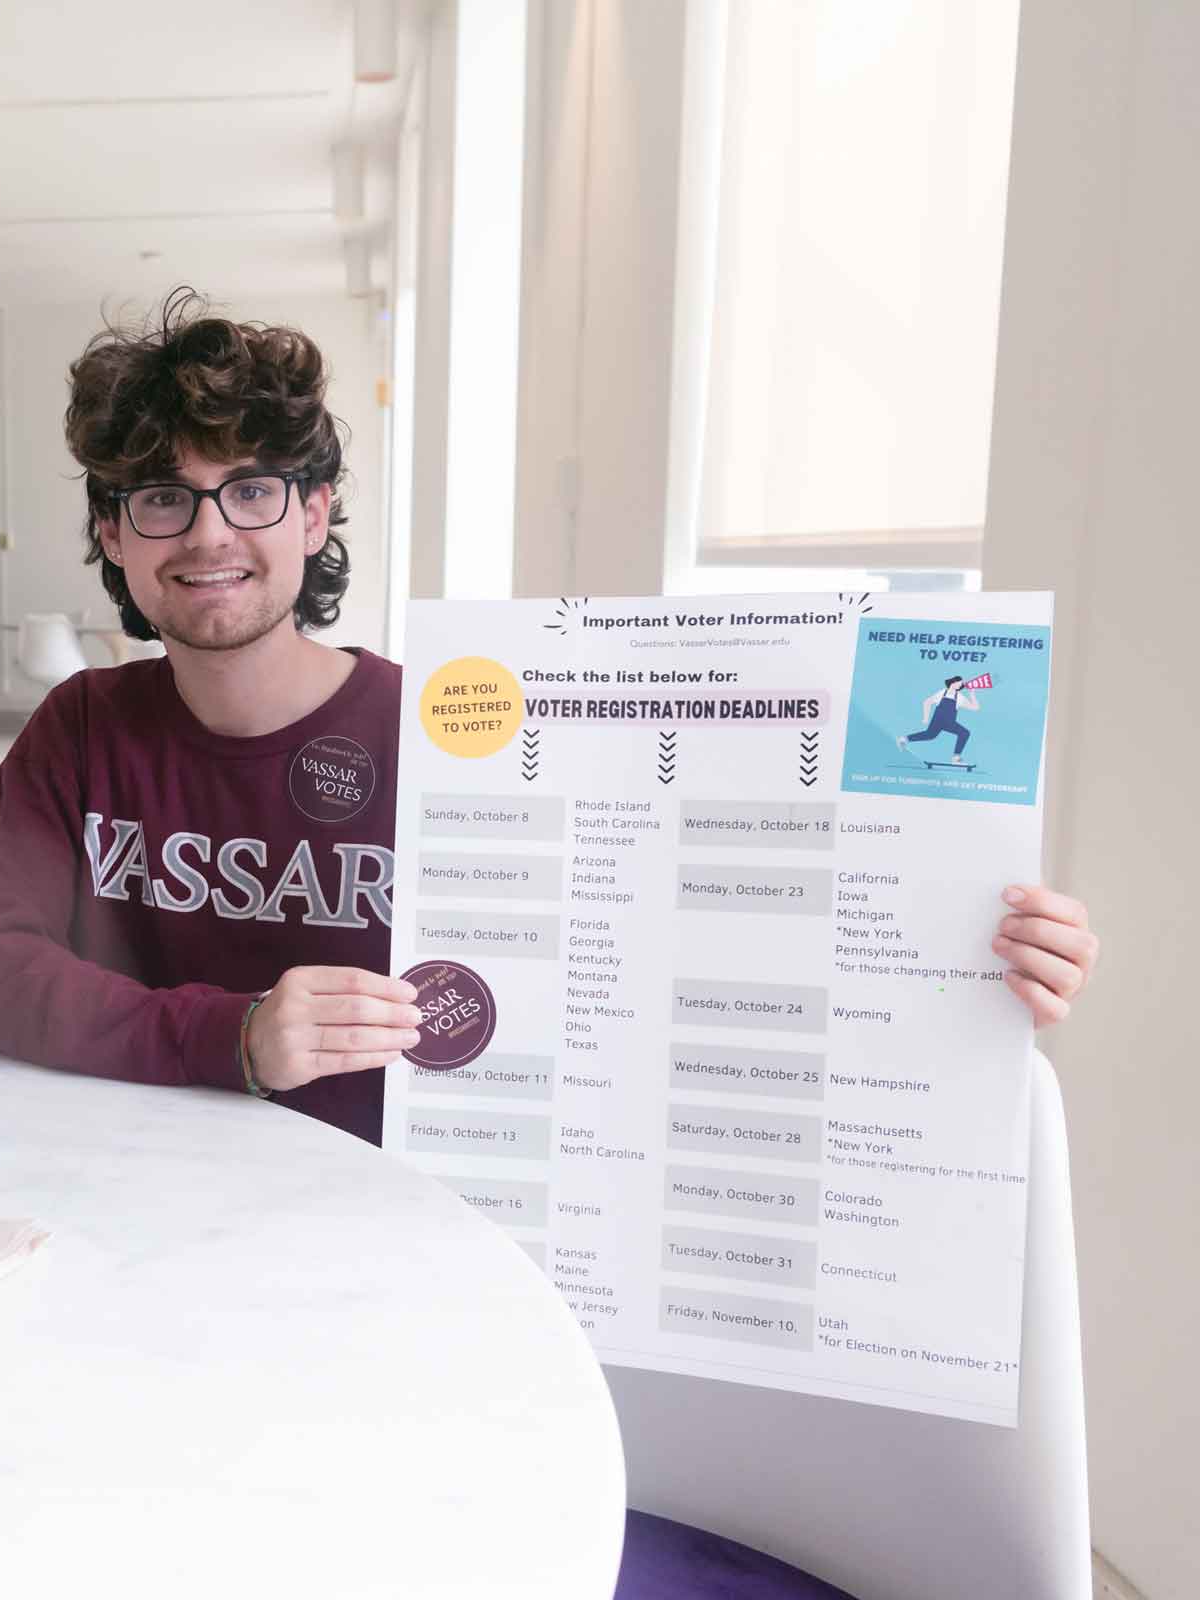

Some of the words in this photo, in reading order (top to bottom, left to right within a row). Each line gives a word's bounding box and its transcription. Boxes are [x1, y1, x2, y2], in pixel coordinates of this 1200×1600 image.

[583, 614, 669, 630] Important
[676, 613, 724, 627] Voter
[730, 612, 844, 626] Information!
[868, 631, 905, 643] NEED
[909, 633, 945, 645] HELP
[948, 634, 1044, 650] REGISTERING
[920, 649, 938, 661] TO
[941, 650, 988, 663] VOTE?
[522, 669, 576, 683] Check
[583, 670, 611, 683] the
[617, 671, 644, 683] list
[650, 670, 702, 683] below
[708, 670, 738, 683] for:
[443, 685, 469, 696] ARE
[471, 683, 498, 694] YOU
[432, 701, 512, 716] REGISTERED
[524, 699, 582, 718] VOTER
[586, 699, 715, 719] REGISTRATION
[719, 699, 820, 719] DEADLINES
[442, 723, 460, 733] TO
[463, 720, 503, 732] VOTE?
[302, 757, 357, 784] VASSAR
[315, 777, 362, 801] VOTES
[575, 800, 611, 811] Rhode
[615, 800, 650, 812] Island
[424, 808, 469, 822] Sunday,
[473, 810, 518, 822] October
[521, 812, 529, 823] 8
[574, 817, 608, 829] South
[612, 818, 660, 830] Carolina
[684, 817, 757, 832] Wednesday,
[760, 819, 809, 832] October
[815, 820, 830, 832] 18
[840, 822, 900, 834] Louisiana
[574, 834, 636, 846] Tennessee
[572, 856, 616, 868] Arizona
[84, 812, 395, 928] VASSAR
[422, 867, 469, 881] Monday,
[473, 869, 518, 881] October
[521, 871, 529, 881] 9
[572, 873, 615, 885] Indiana
[838, 872, 899, 886] California
[571, 890, 634, 904] Mississippi
[681, 882, 732, 897] Monday,
[736, 885, 784, 898] October
[788, 886, 804, 897] 23
[837, 891, 868, 902] Iowa
[836, 908, 894, 923] Michigan
[569, 918, 610, 930] Florida
[421, 927, 470, 941] Tuesday,
[473, 929, 518, 942] October
[523, 931, 538, 943] 10
[874, 928, 903, 940] York
[569, 936, 615, 950] Georgia
[835, 944, 919, 960] Pennsylvania
[568, 953, 622, 967] Kentucky
[567, 970, 618, 983] Montana
[859, 963, 890, 976] those
[893, 965, 946, 980] changing
[949, 968, 977, 980] their
[567, 987, 610, 1000] Nevada
[566, 1004, 591, 1016] New
[595, 1006, 635, 1018] Mexico
[677, 996, 731, 1012] Tuesday,
[734, 1000, 782, 1014] October
[787, 1003, 803, 1015] 24
[426, 998, 481, 1036] VOTES
[832, 1007, 892, 1023] Wyoming
[565, 1021, 592, 1033] Ohio
[564, 1038, 599, 1050] Texas
[484, 1070, 529, 1083] October
[535, 1074, 548, 1084] 11
[674, 1060, 746, 1078] Wednesday,
[750, 1066, 799, 1081] October
[803, 1071, 819, 1083] 25
[563, 1076, 612, 1089] Missouri
[829, 1073, 857, 1086] New
[861, 1076, 931, 1092] Hampshire
[411, 1124, 449, 1138] Friday,
[452, 1127, 497, 1141] October
[502, 1130, 517, 1142] 13
[560, 1126, 594, 1139] Idaho
[671, 1121, 729, 1138] Saturday,
[733, 1127, 781, 1143] October
[785, 1132, 801, 1144] 28
[827, 1120, 923, 1140] Massachusetts
[560, 1143, 593, 1156] North
[596, 1146, 645, 1160] Carolina
[865, 1141, 894, 1155] York
[848, 1156, 876, 1170] those
[880, 1159, 936, 1176] registering
[939, 1165, 953, 1178] for
[957, 1167, 974, 1180] the
[977, 1169, 999, 1182] first
[1002, 1173, 1026, 1184] time
[673, 1183, 723, 1200] Monday,
[726, 1189, 775, 1204] October
[779, 1194, 795, 1206] 30
[824, 1190, 883, 1207] Colorado
[508, 1198, 523, 1209] 16
[557, 1202, 601, 1216] Virginia
[824, 1208, 900, 1228] Washington
[555, 1248, 597, 1260] Kansas
[668, 1243, 722, 1261] Tuesday,
[725, 1250, 774, 1267] October
[778, 1256, 793, 1269] 31
[554, 1264, 589, 1277] Maine
[821, 1263, 897, 1282] Connecticut
[553, 1280, 614, 1297] Minnesota
[581, 1300, 619, 1316] Jersey
[666, 1304, 708, 1321] Friday,
[712, 1309, 774, 1329] November
[778, 1320, 798, 1334] 10,
[818, 1316, 848, 1331] Utah
[846, 1338, 897, 1357] Election
[901, 1347, 918, 1359] on
[921, 1350, 989, 1370] November
